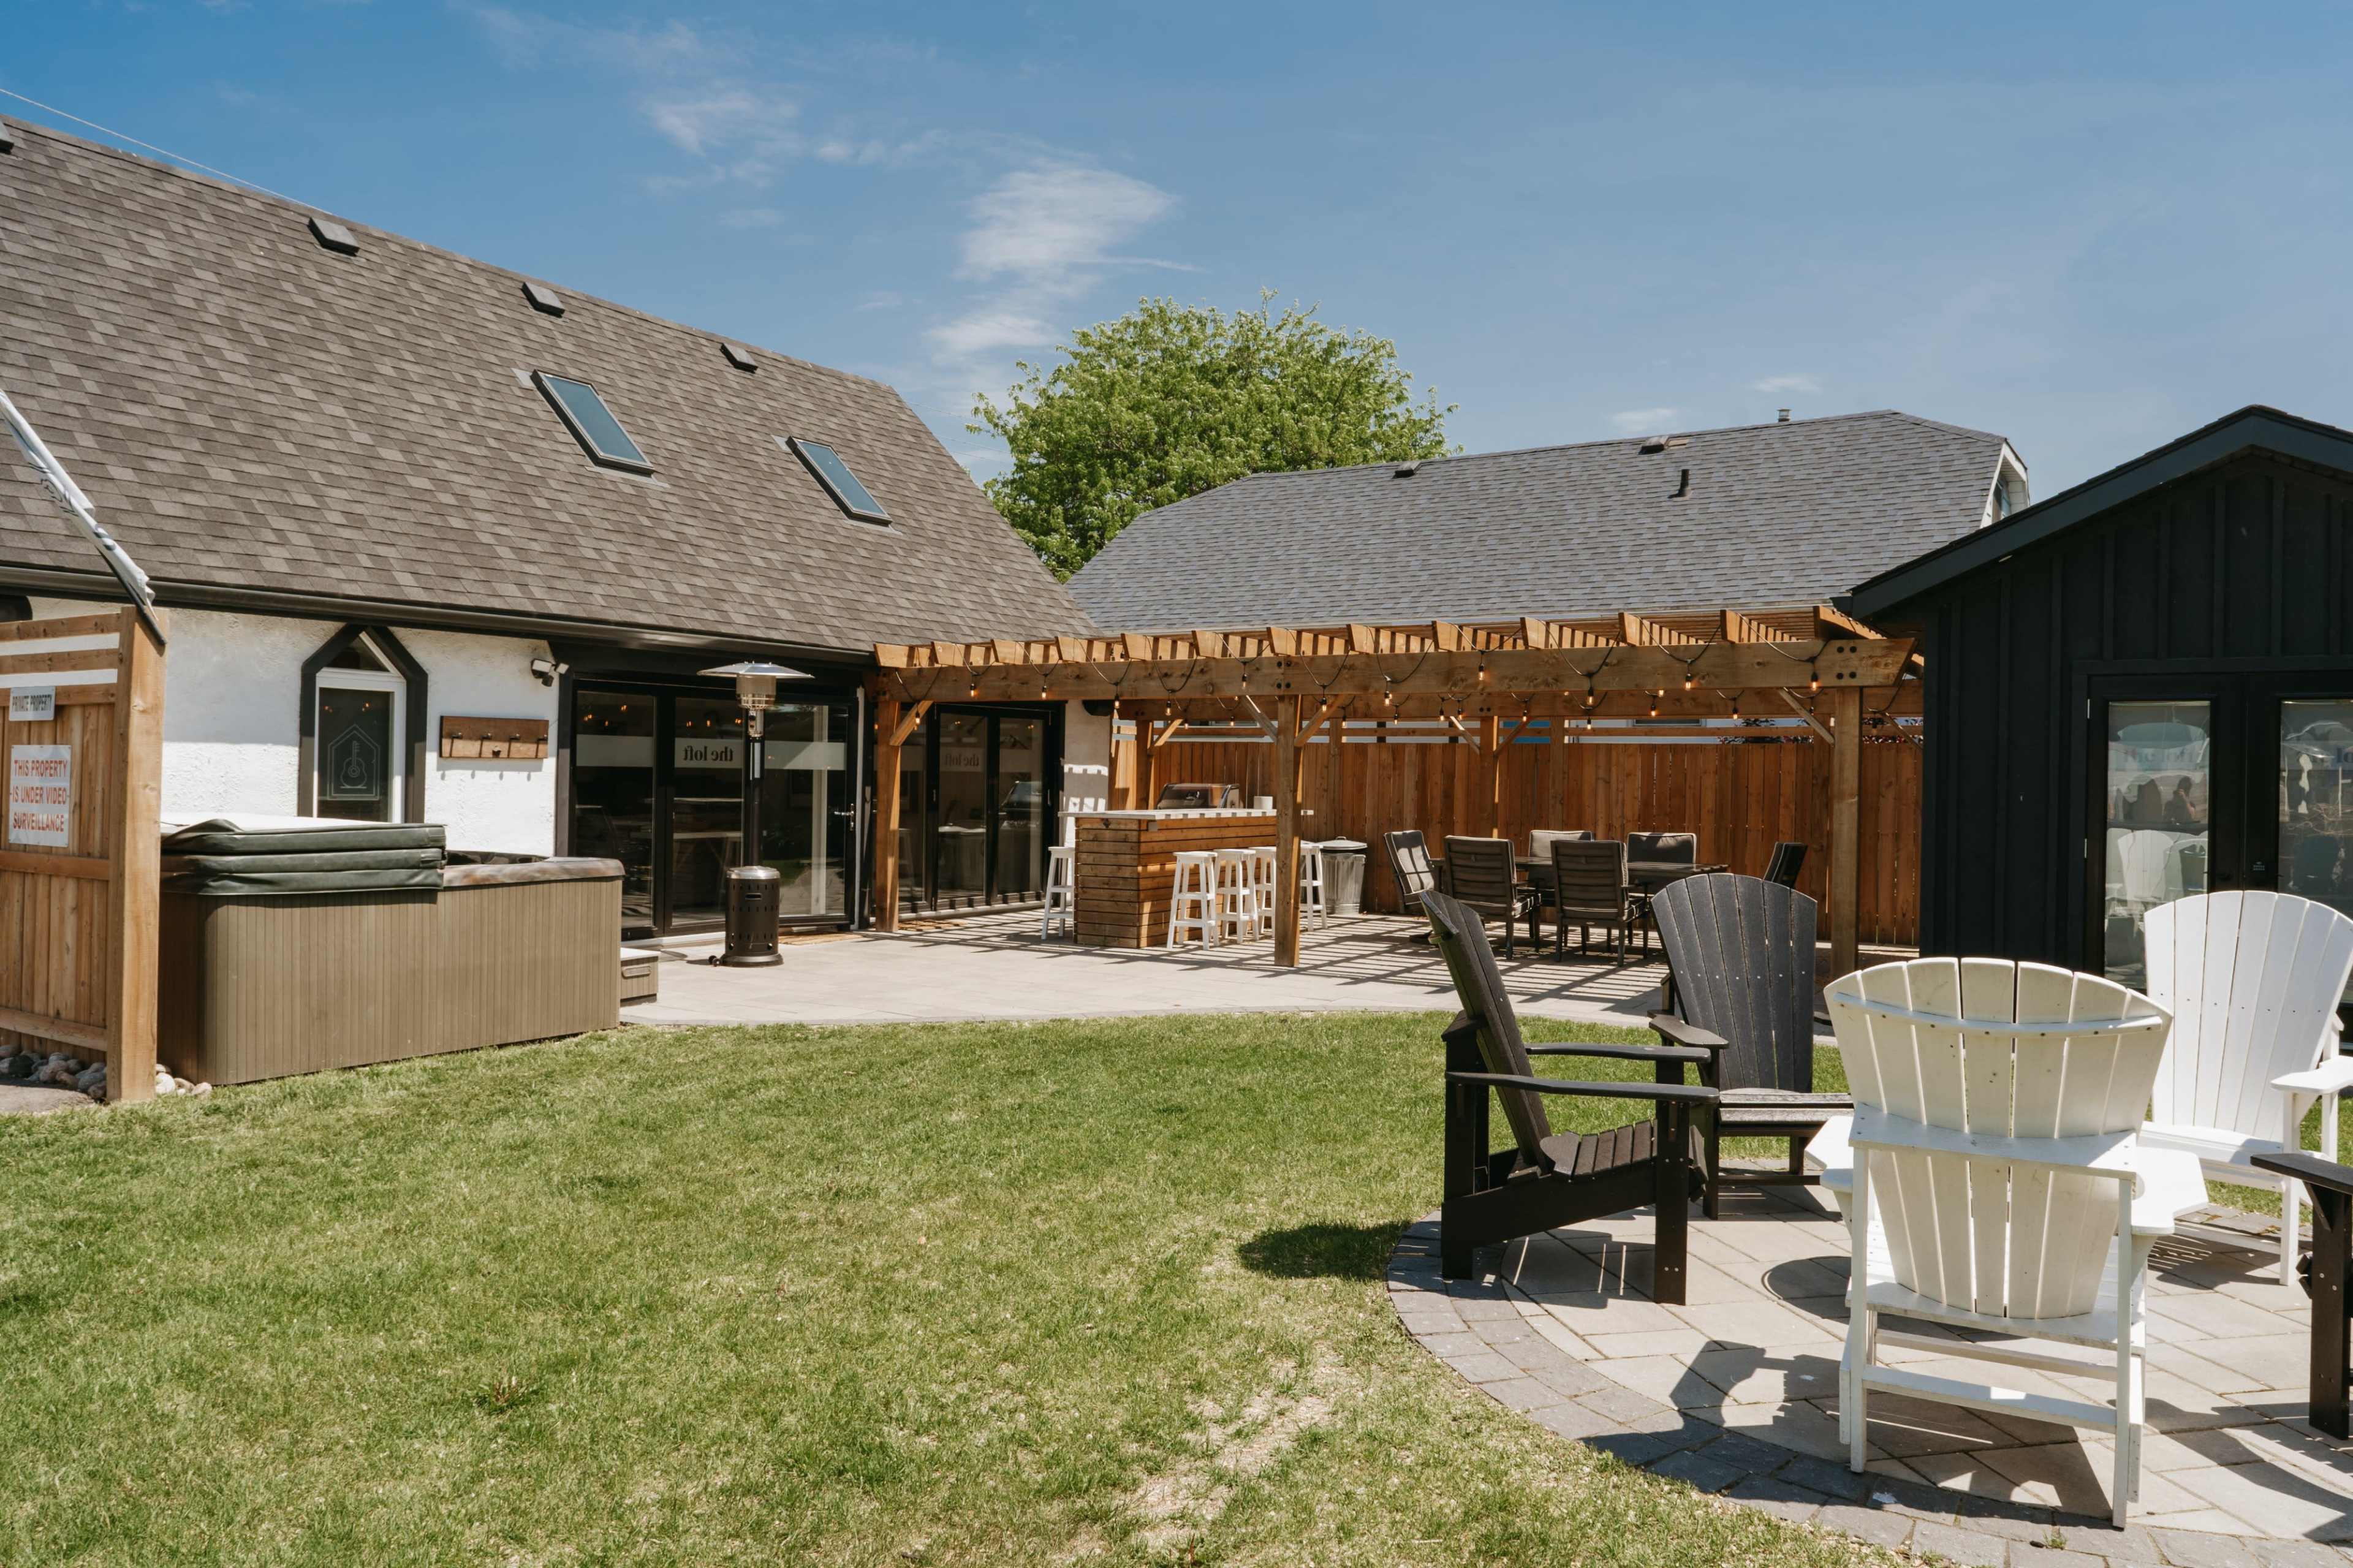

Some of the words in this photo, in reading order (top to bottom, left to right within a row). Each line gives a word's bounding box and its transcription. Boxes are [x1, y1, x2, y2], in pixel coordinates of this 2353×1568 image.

[30, 694, 52, 711] PROPERTY
[13, 760, 29, 777] THIS
[31, 759, 67, 778] PROPERTY
[12, 785, 20, 803] IS
[21, 786, 44, 804] UNDER
[46, 787, 67, 805] VIDEO
[13, 812, 64, 832] SURVEILLANCE
